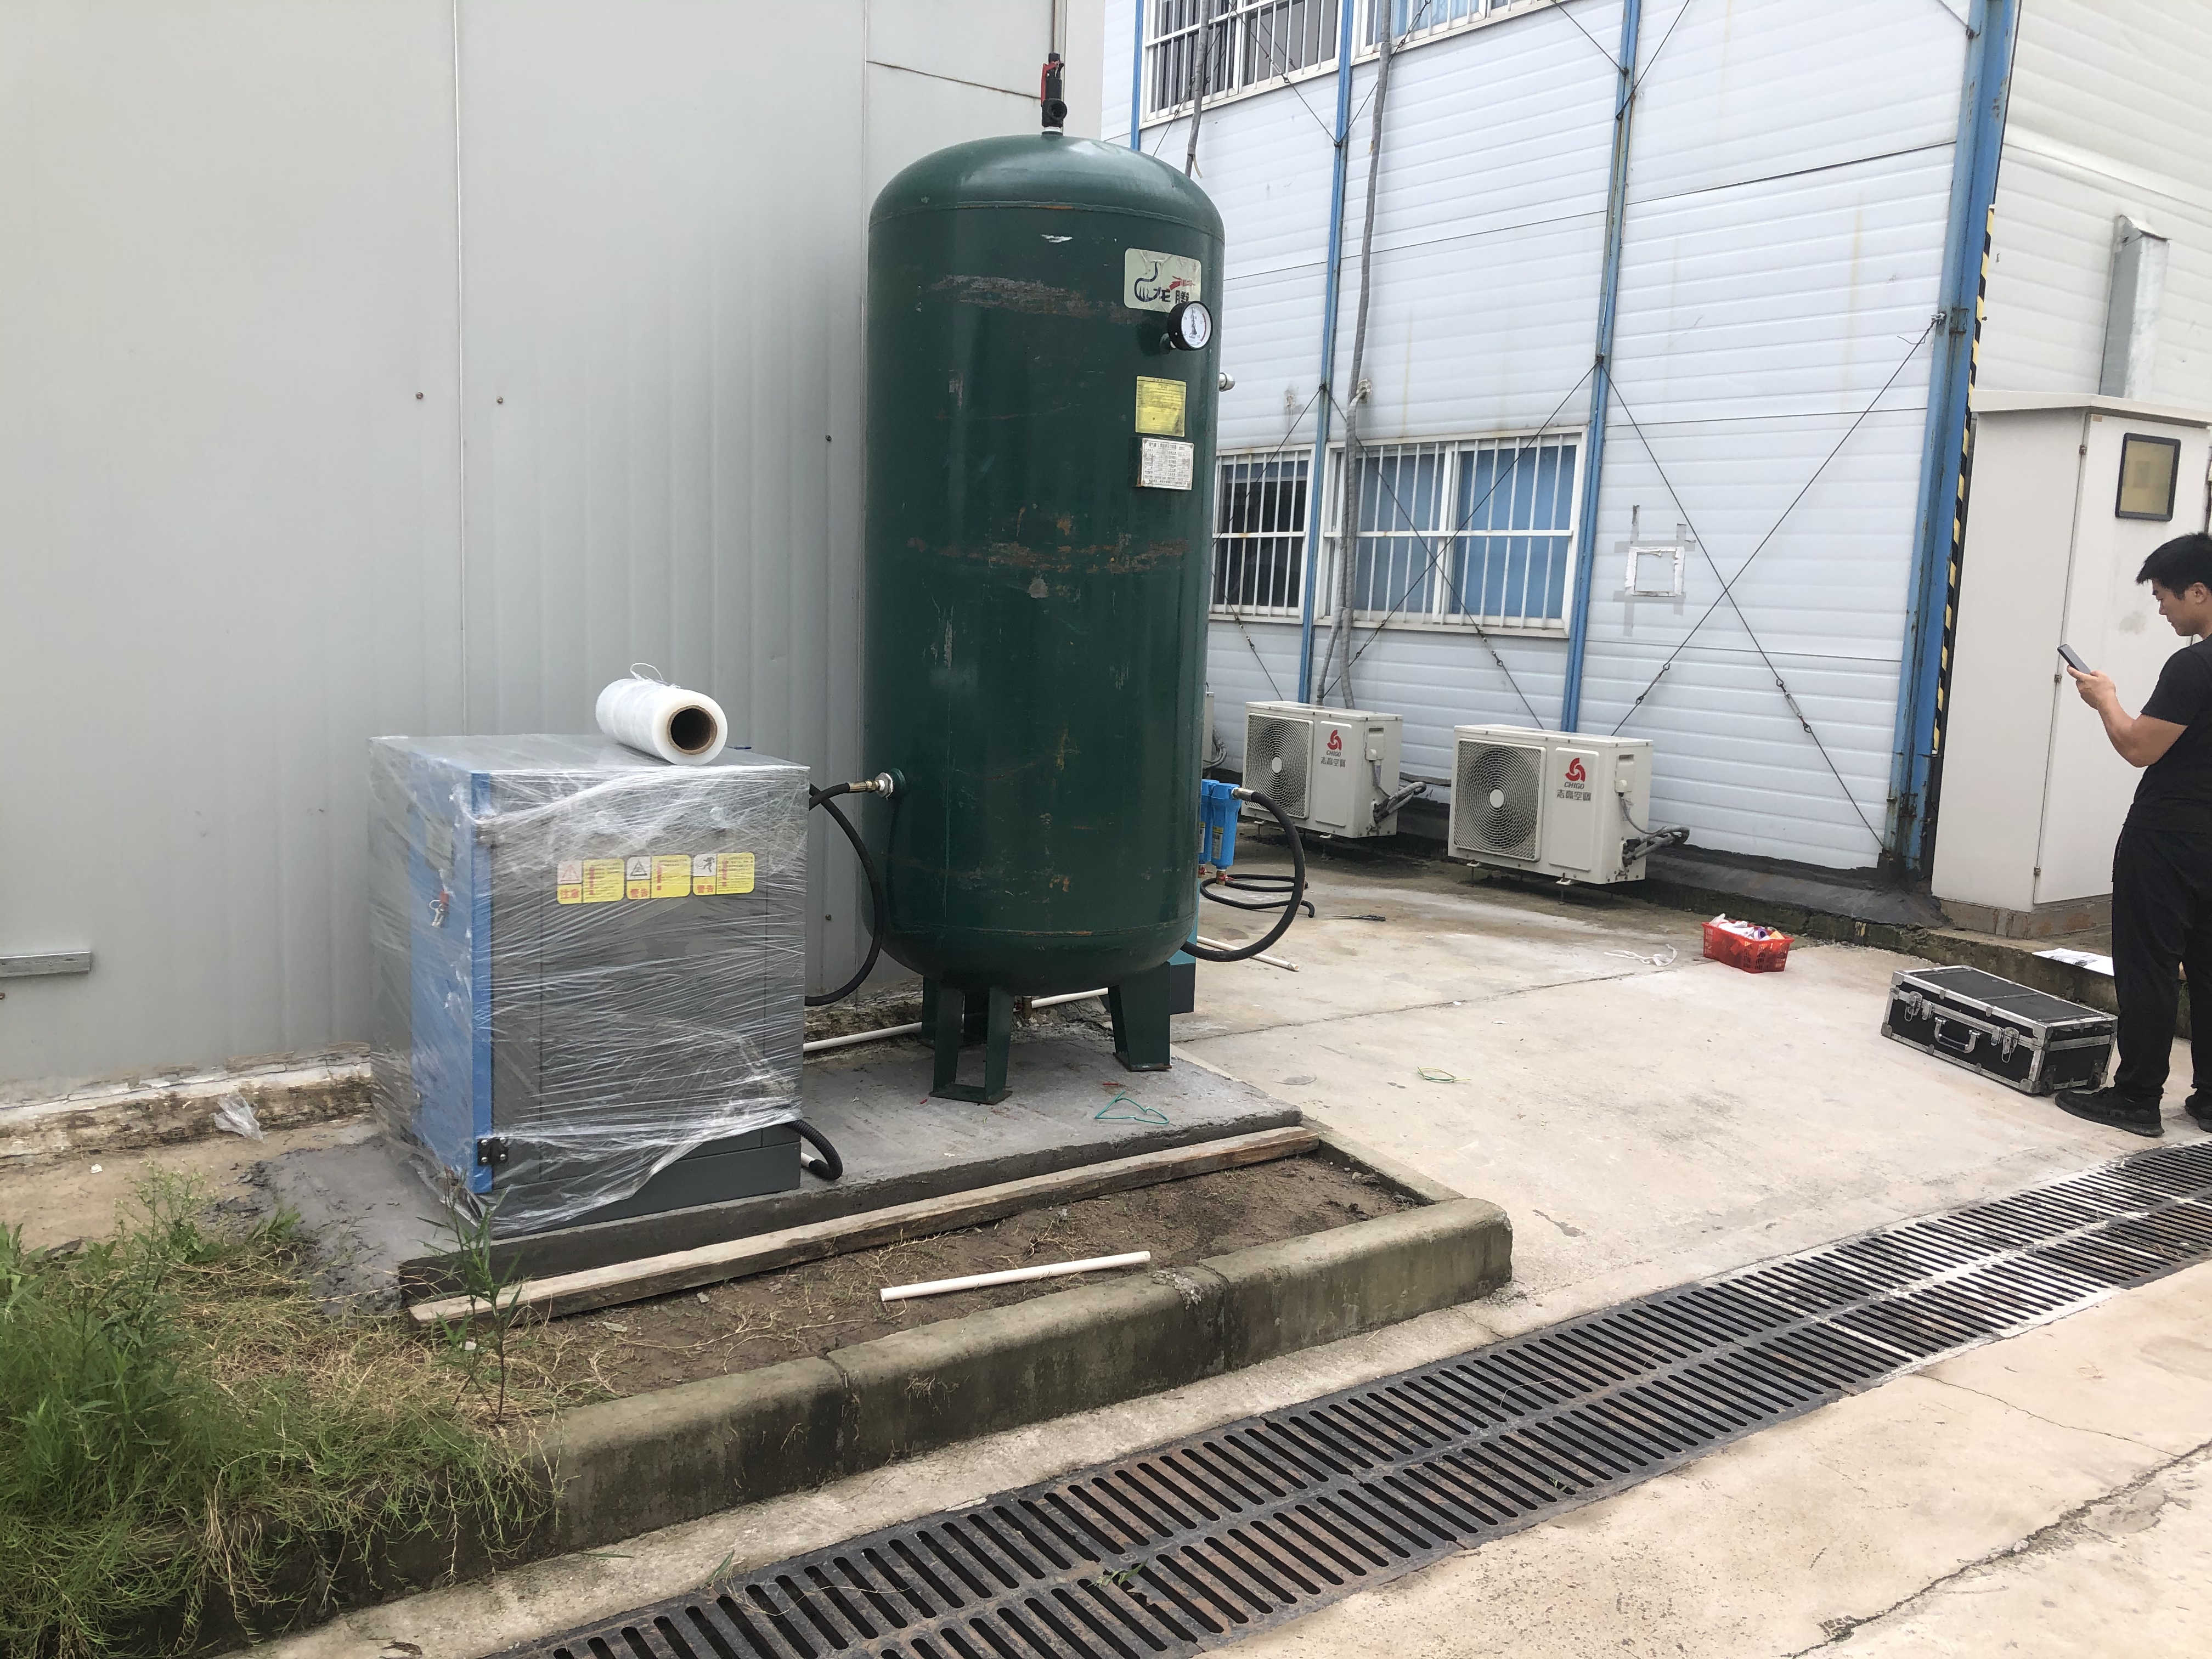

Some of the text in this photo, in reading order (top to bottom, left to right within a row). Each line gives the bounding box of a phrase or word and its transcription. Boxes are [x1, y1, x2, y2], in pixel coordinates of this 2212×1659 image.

[1564, 781, 1585, 789] CHIGO
[630, 888, 648, 898] 警告
[697, 884, 715, 894] 警告
